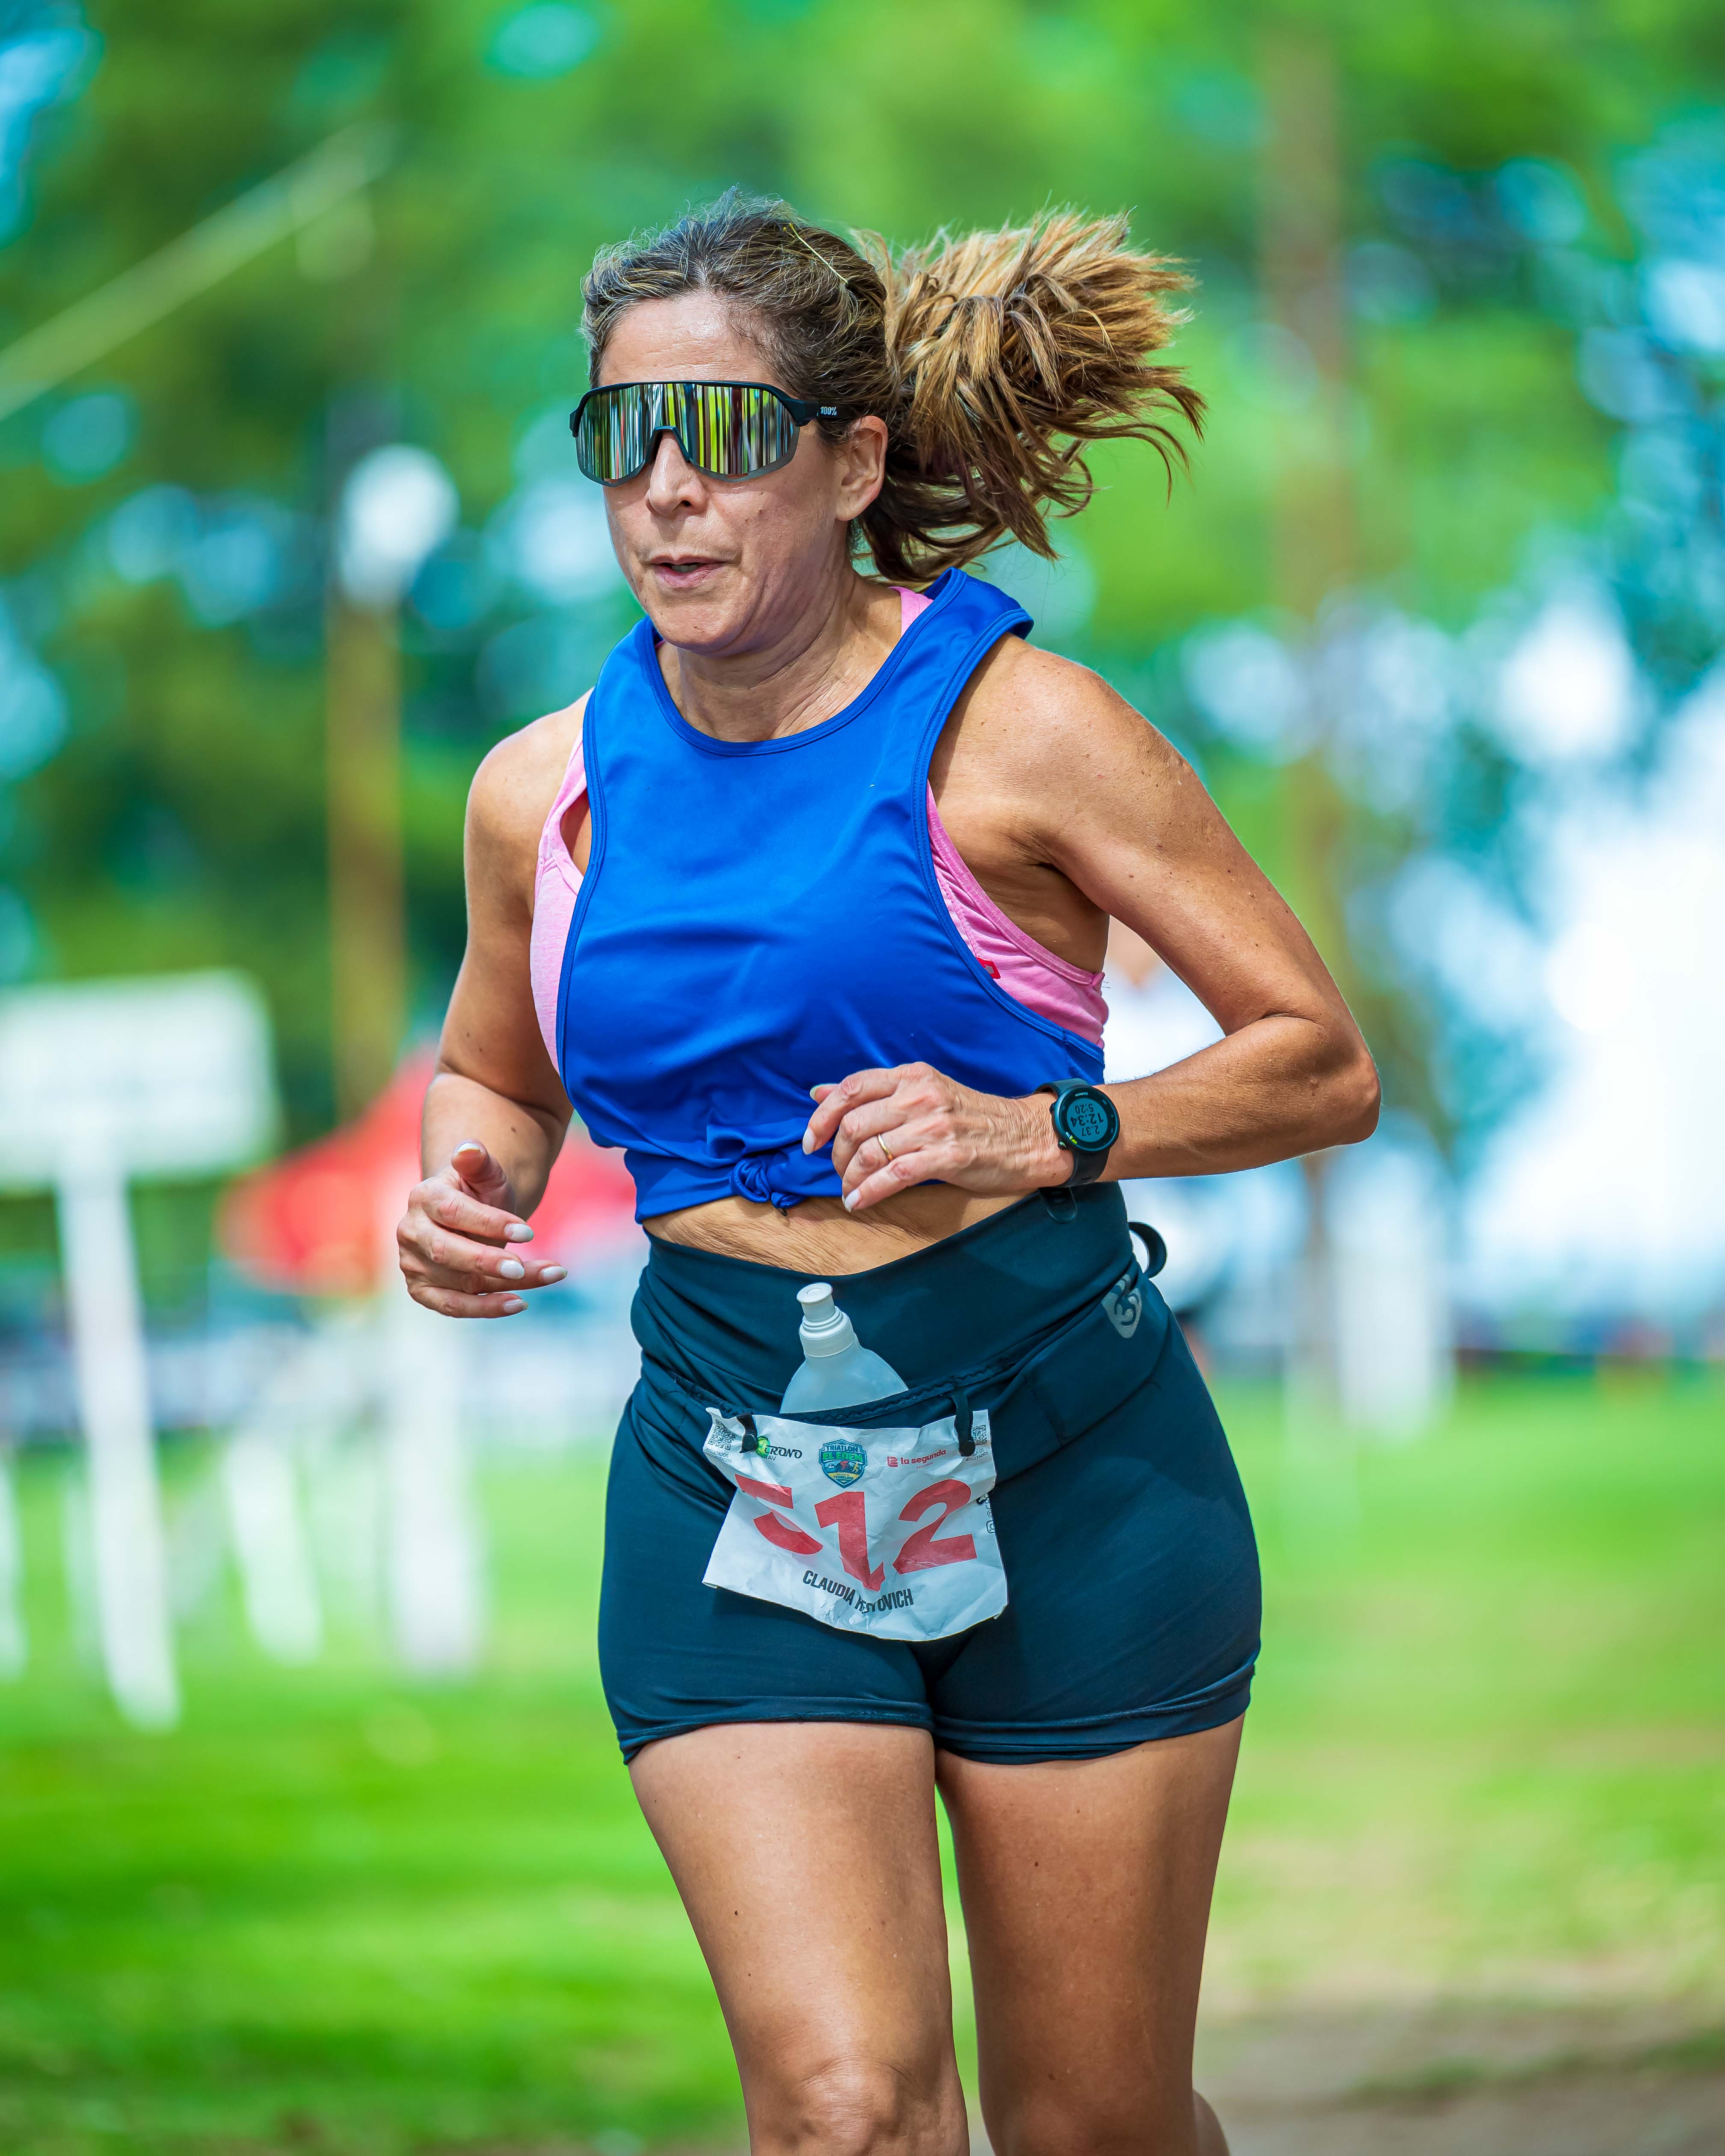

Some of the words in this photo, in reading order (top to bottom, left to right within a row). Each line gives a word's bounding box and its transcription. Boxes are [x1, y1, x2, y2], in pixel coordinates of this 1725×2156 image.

[820, 406, 837, 415] 100%
[1074, 1103, 1094, 1114] 5:20
[1070, 1112, 1104, 1127] 12:34
[1082, 1125, 1100, 1136] 2.37
[765, 1445, 803, 1459] CRONO
[823, 1452, 835, 1460] EL
[836, 1452, 863, 1462] EDEN
[911, 1449, 946, 1464] segunda
[802, 1570, 856, 1606] CLAUDIA
